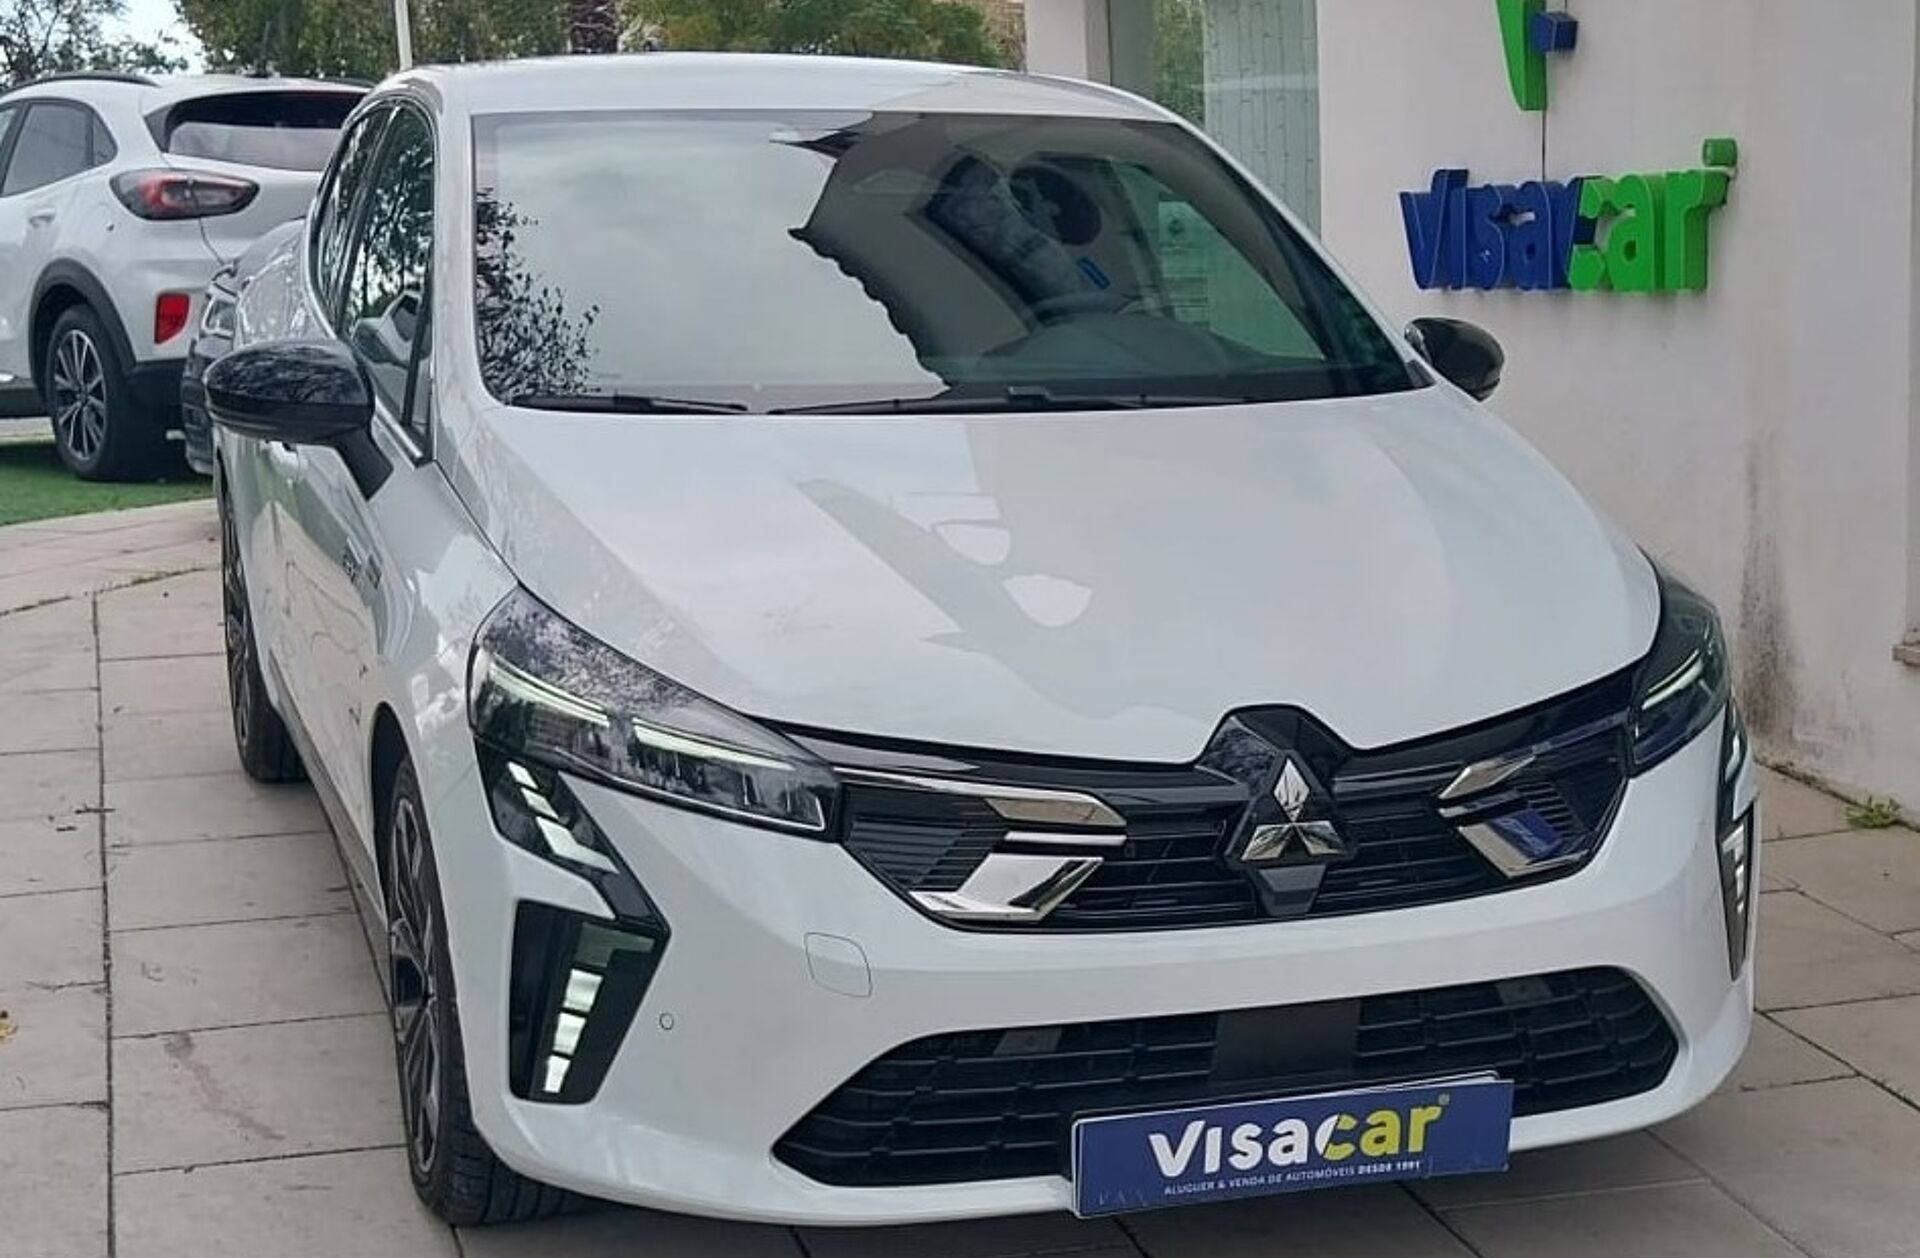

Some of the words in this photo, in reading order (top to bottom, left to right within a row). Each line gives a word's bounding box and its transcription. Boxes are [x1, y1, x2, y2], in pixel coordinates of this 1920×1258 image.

[1229, 1174, 1266, 1188] VENDA
[1267, 1172, 1282, 1185] DE
[1357, 1161, 1393, 1176] DESDE
